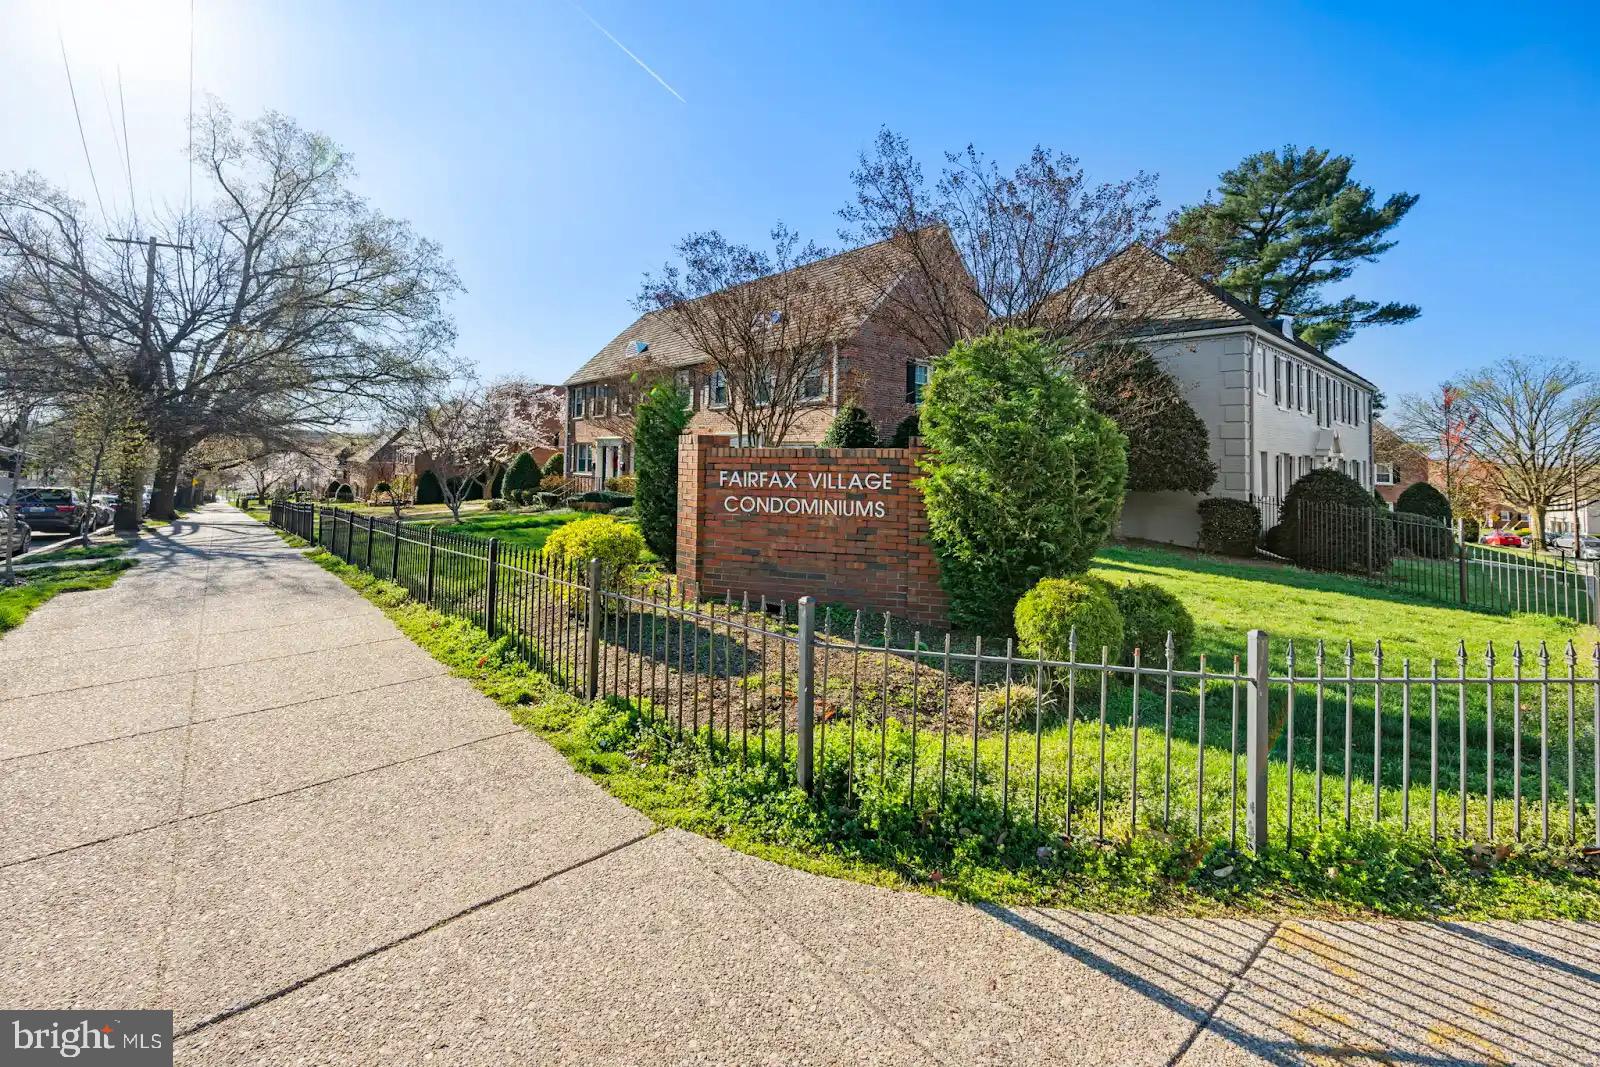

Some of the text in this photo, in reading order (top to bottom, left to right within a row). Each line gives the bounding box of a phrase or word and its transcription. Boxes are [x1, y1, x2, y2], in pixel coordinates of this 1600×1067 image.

[719, 470, 893, 490] FAIRFAX VILLAGE
[723, 495, 887, 518] CONDOMINIUMS
